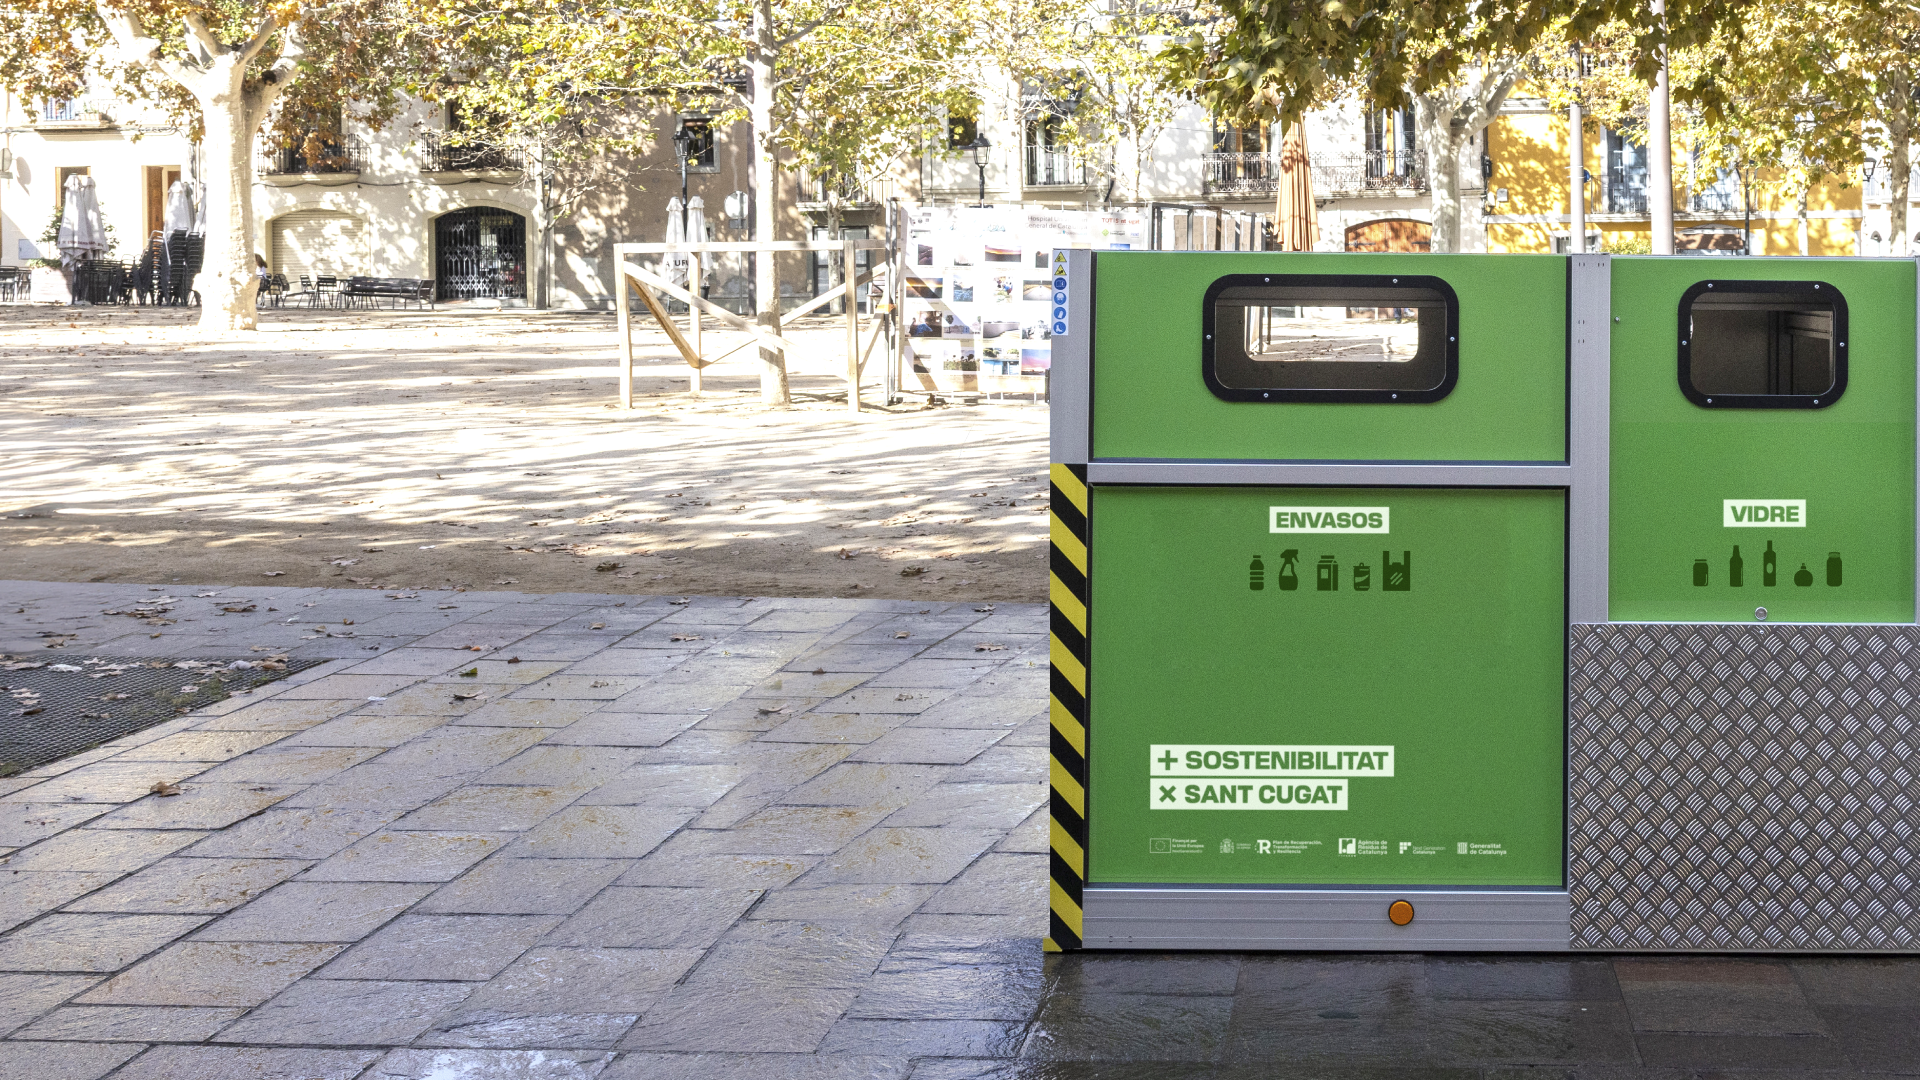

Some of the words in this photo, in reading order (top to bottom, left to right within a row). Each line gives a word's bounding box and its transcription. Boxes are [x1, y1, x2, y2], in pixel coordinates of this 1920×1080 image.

[1027, 215, 1053, 223] Hospital
[1276, 512, 1383, 529] ENVASOS
[1730, 505, 1800, 523] VIDRE
[1185, 750, 1389, 770] SOSTENIBILITAT
[1184, 784, 1254, 804] SANT
[1258, 784, 1343, 804] CUGAT
[1478, 849, 1507, 857] Catalunya
